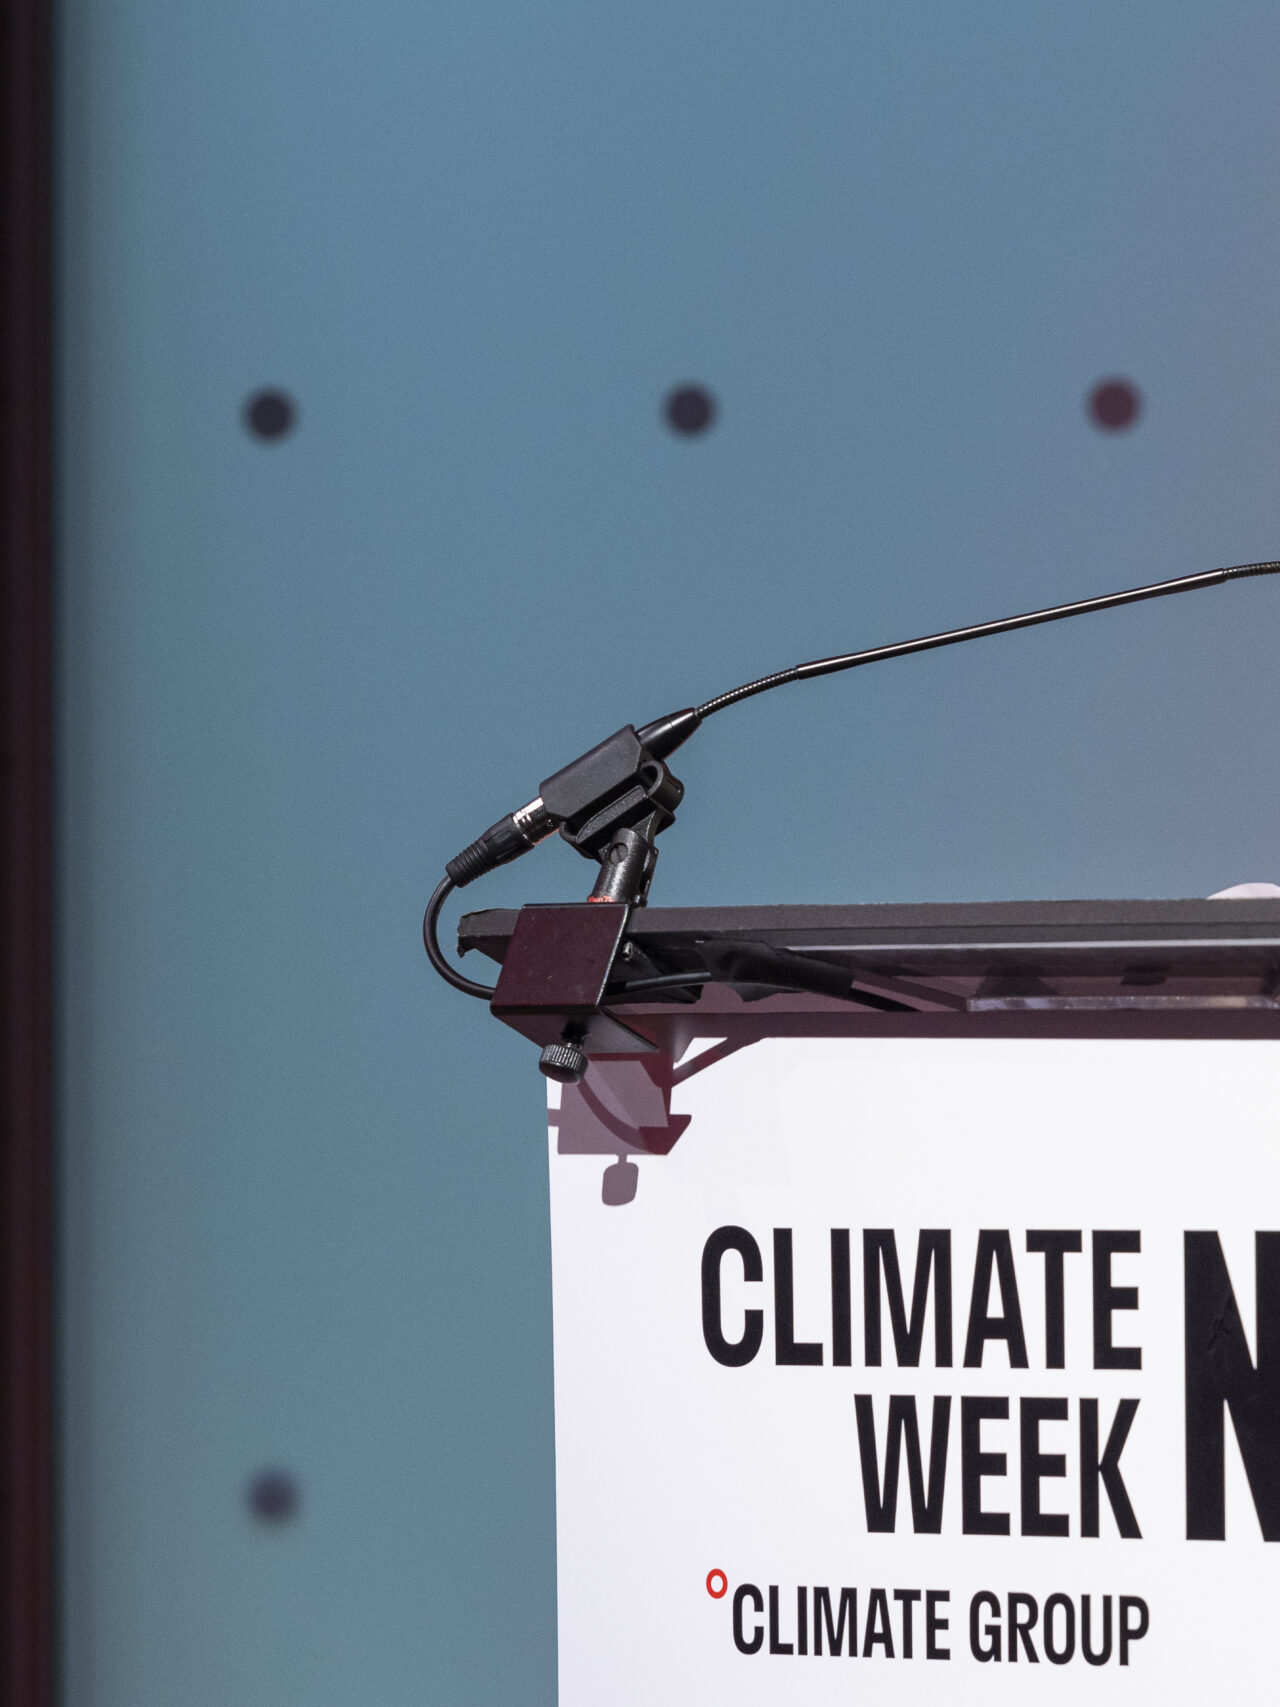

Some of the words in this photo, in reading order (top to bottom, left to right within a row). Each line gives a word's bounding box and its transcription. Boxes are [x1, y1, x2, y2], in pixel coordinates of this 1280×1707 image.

[702, 1226, 1142, 1370] CLIMATE
[854, 1395, 1143, 1539] WEEK
[732, 1583, 950, 1661] CLIMATE
[969, 1590, 1149, 1666] GROUP
